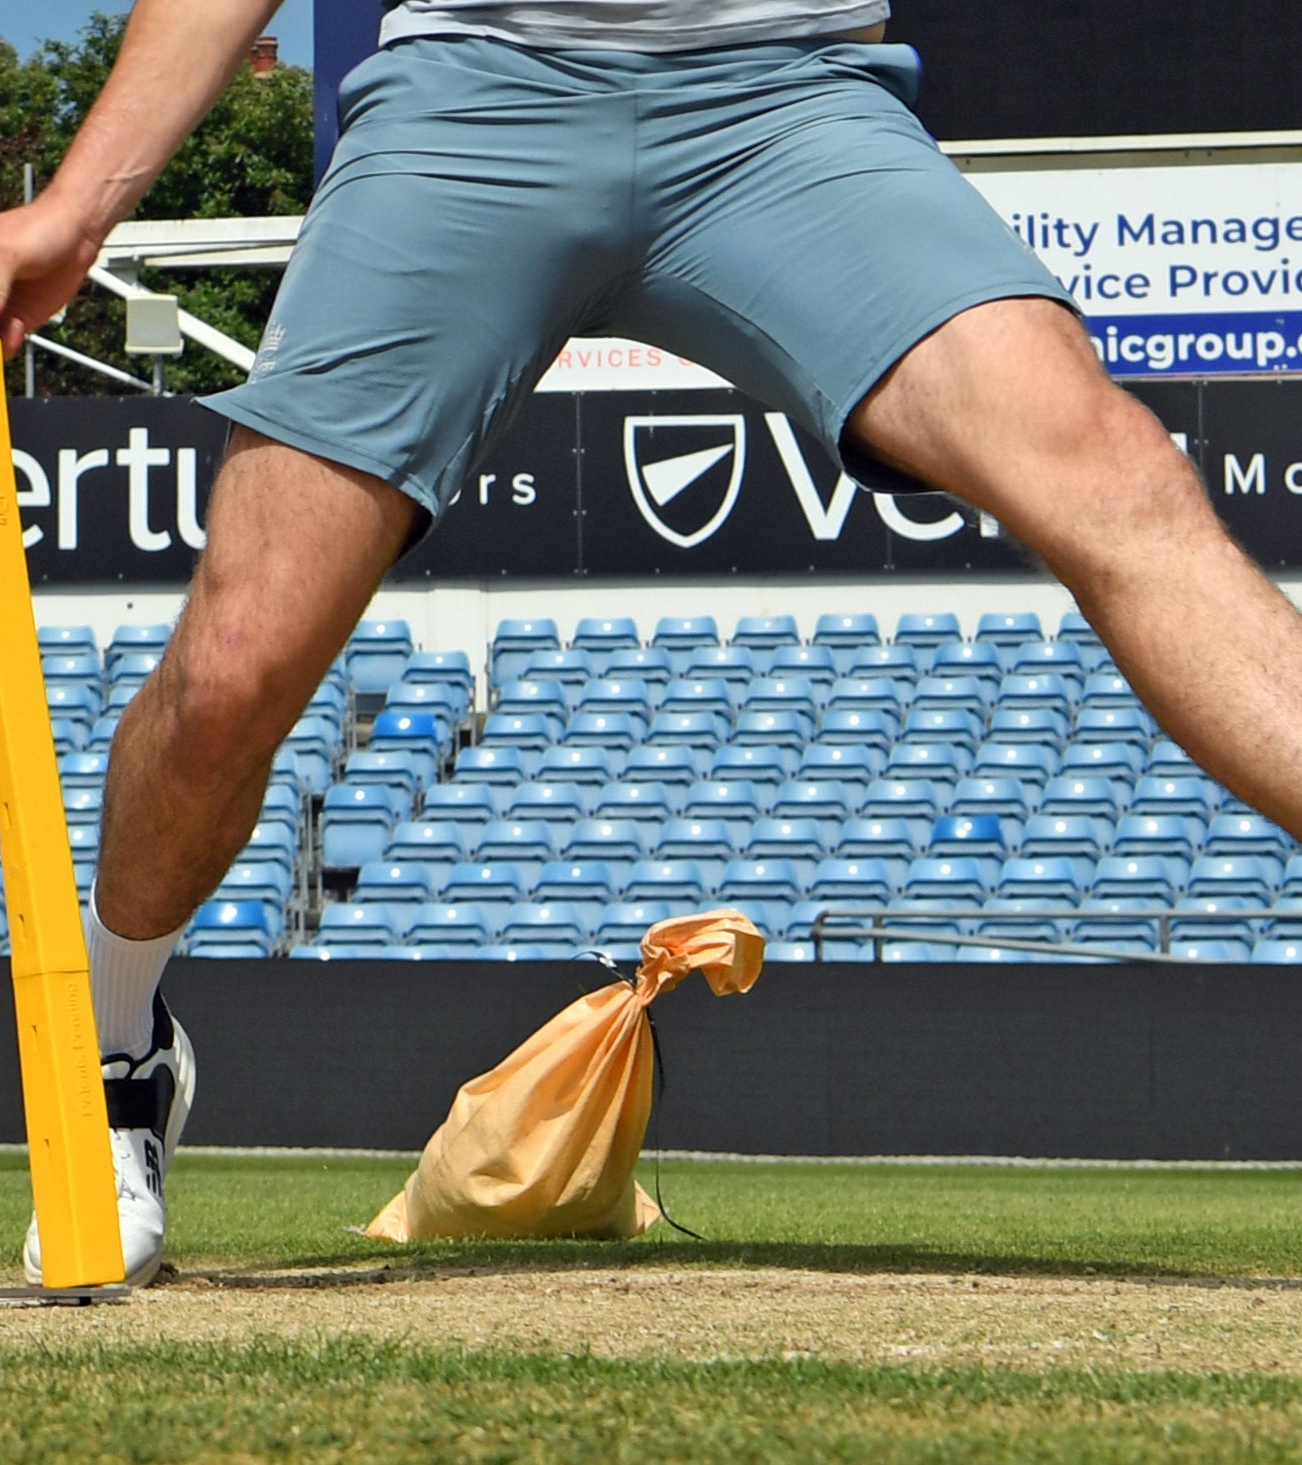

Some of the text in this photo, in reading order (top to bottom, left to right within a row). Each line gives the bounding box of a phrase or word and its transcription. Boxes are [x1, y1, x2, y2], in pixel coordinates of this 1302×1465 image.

[1012, 212, 1100, 257] ility
[1054, 264, 1151, 300] vice
[557, 349, 662, 369] RVICES
